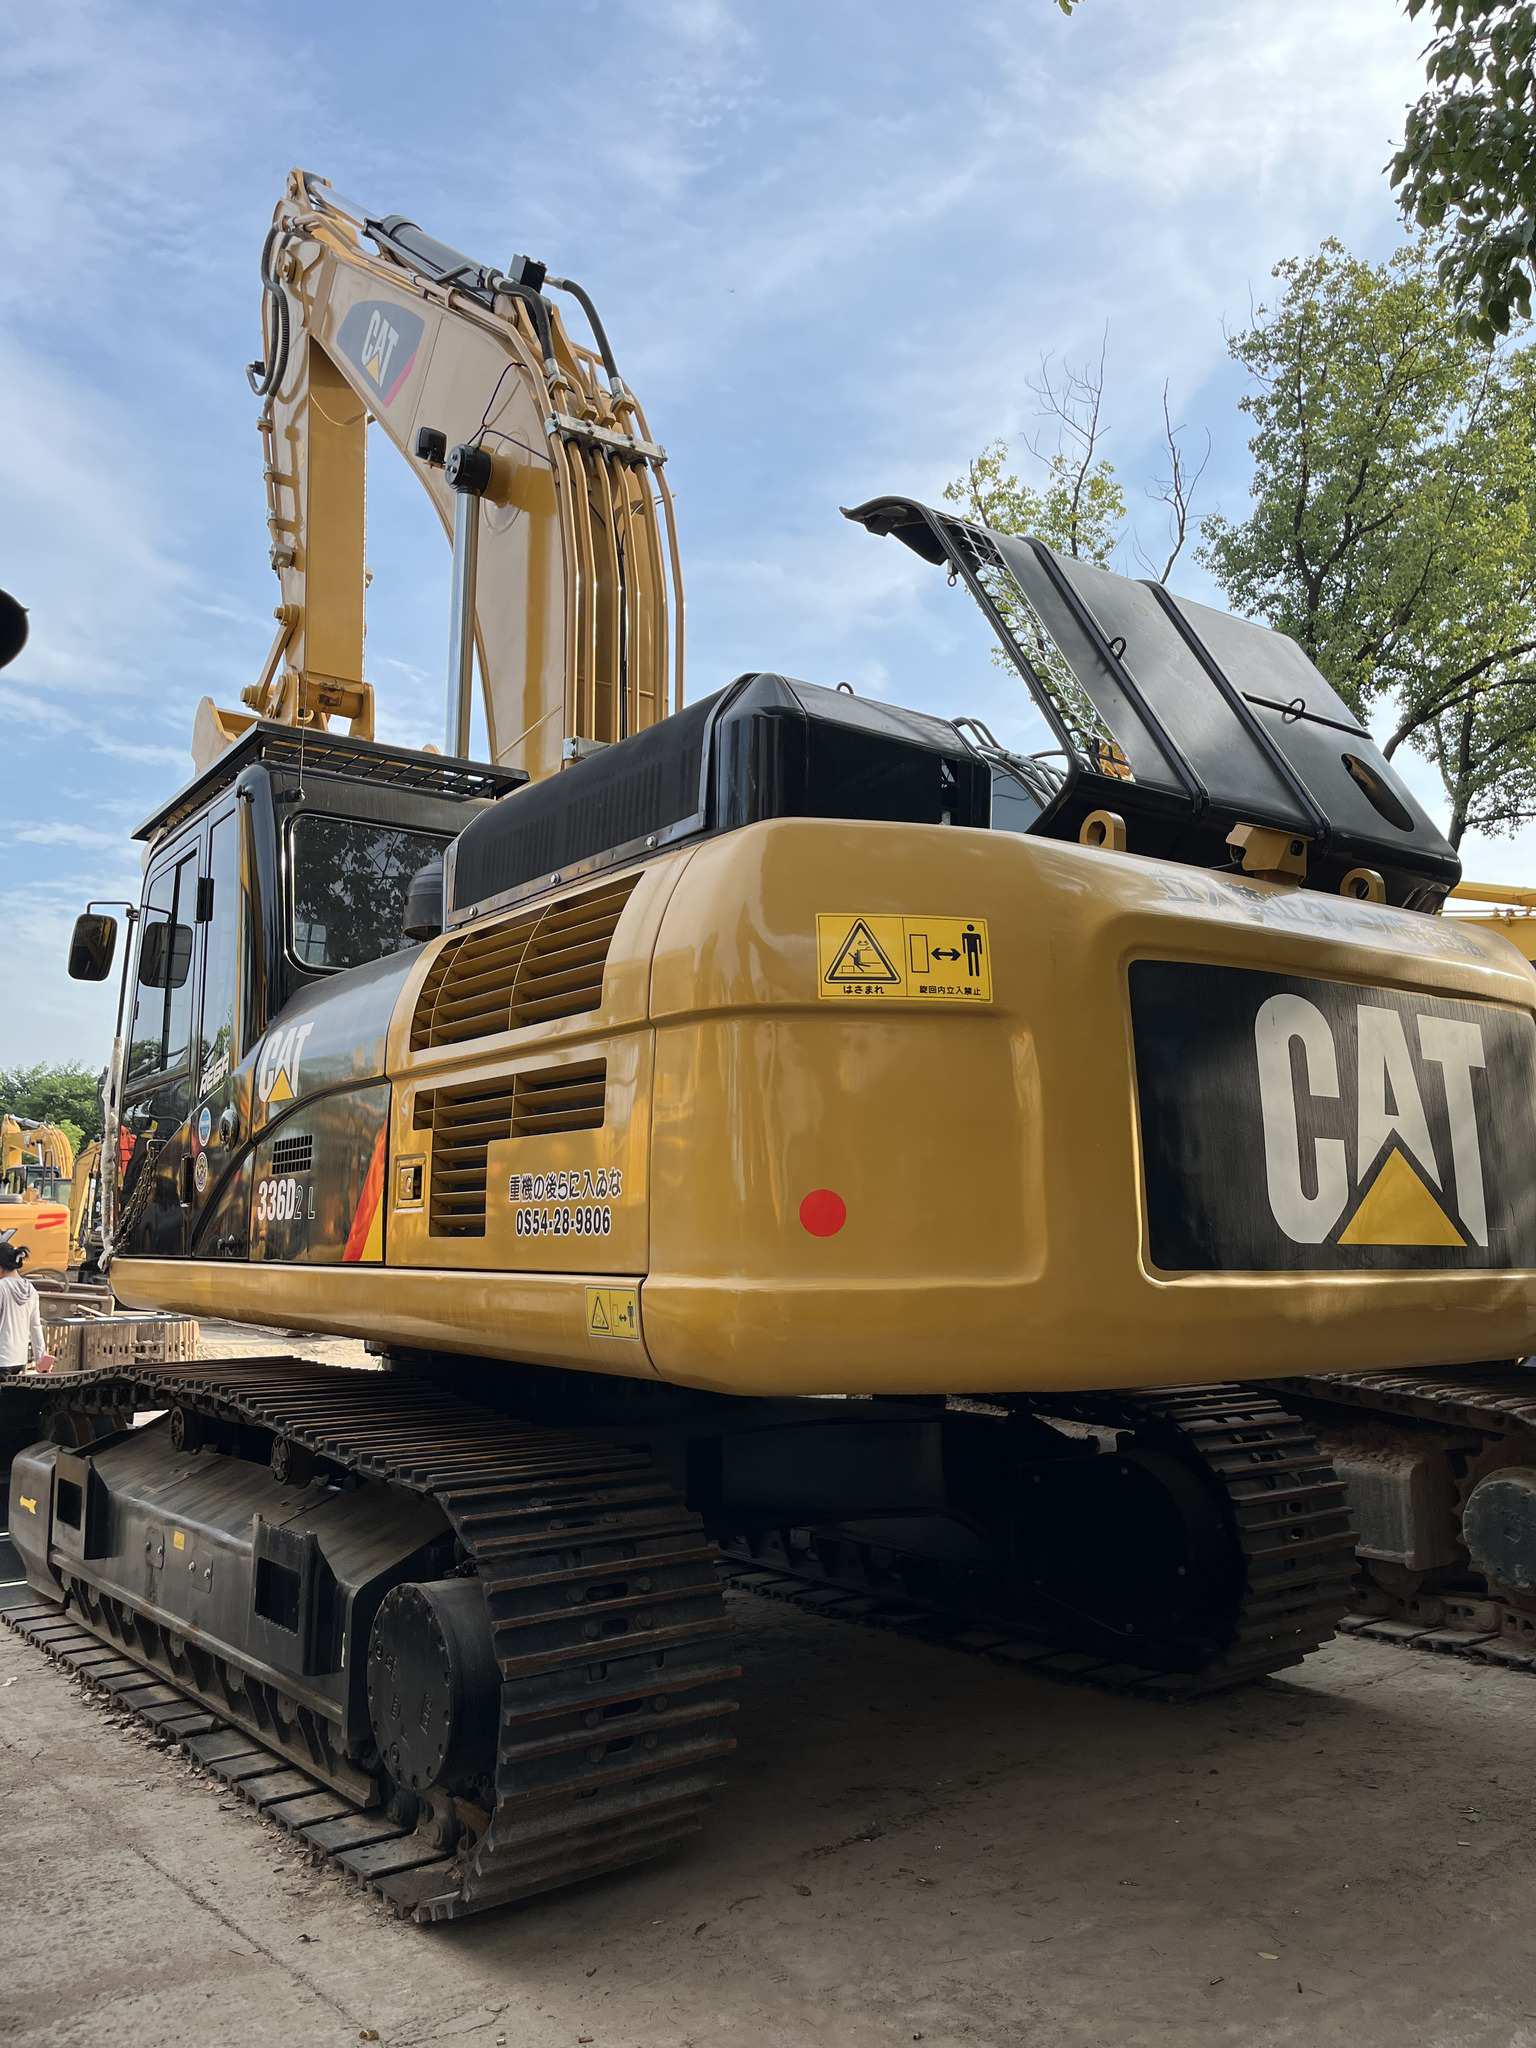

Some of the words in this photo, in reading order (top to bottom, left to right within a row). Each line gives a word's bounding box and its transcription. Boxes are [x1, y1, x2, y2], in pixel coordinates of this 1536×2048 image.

[361, 309, 400, 388] CAT
[843, 984, 884, 994] はさまれ
[258, 1022, 315, 1103] CAT
[1255, 993, 1489, 1247] CAT
